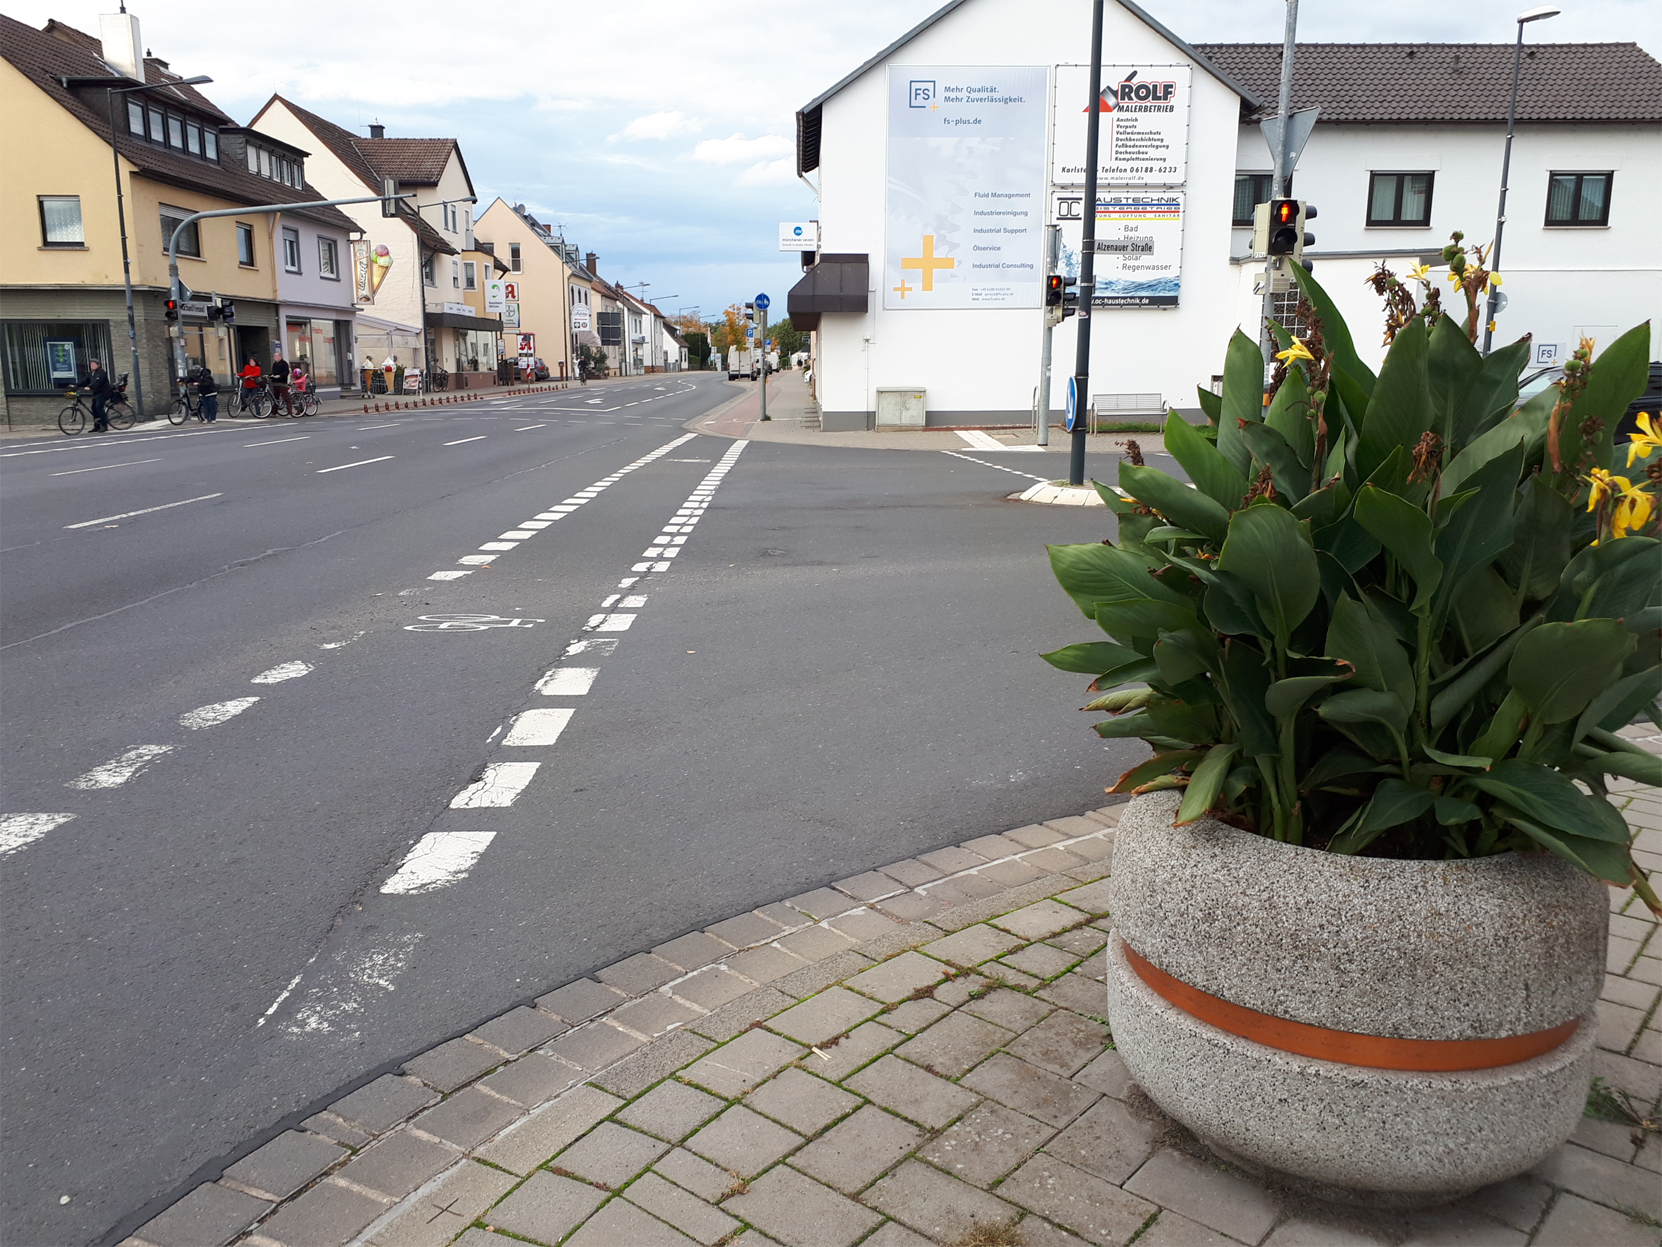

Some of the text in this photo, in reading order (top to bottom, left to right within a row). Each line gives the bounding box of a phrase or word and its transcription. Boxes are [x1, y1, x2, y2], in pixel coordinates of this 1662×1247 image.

[914, 88, 930, 101] FS
[966, 86, 1000, 94] Qualität.
[1119, 83, 1175, 102] ROLF
[966, 96, 1026, 105] Zuverlässigkeit.
[1116, 104, 1174, 113] MALERBETRIEB
[944, 118, 982, 126] fs-plus.de
[1059, 201, 1080, 216] OC
[1097, 242, 1152, 252] Alzenauer Straße
[1122, 263, 1172, 272] Regenwasser
[1541, 350, 1552, 358] FS
